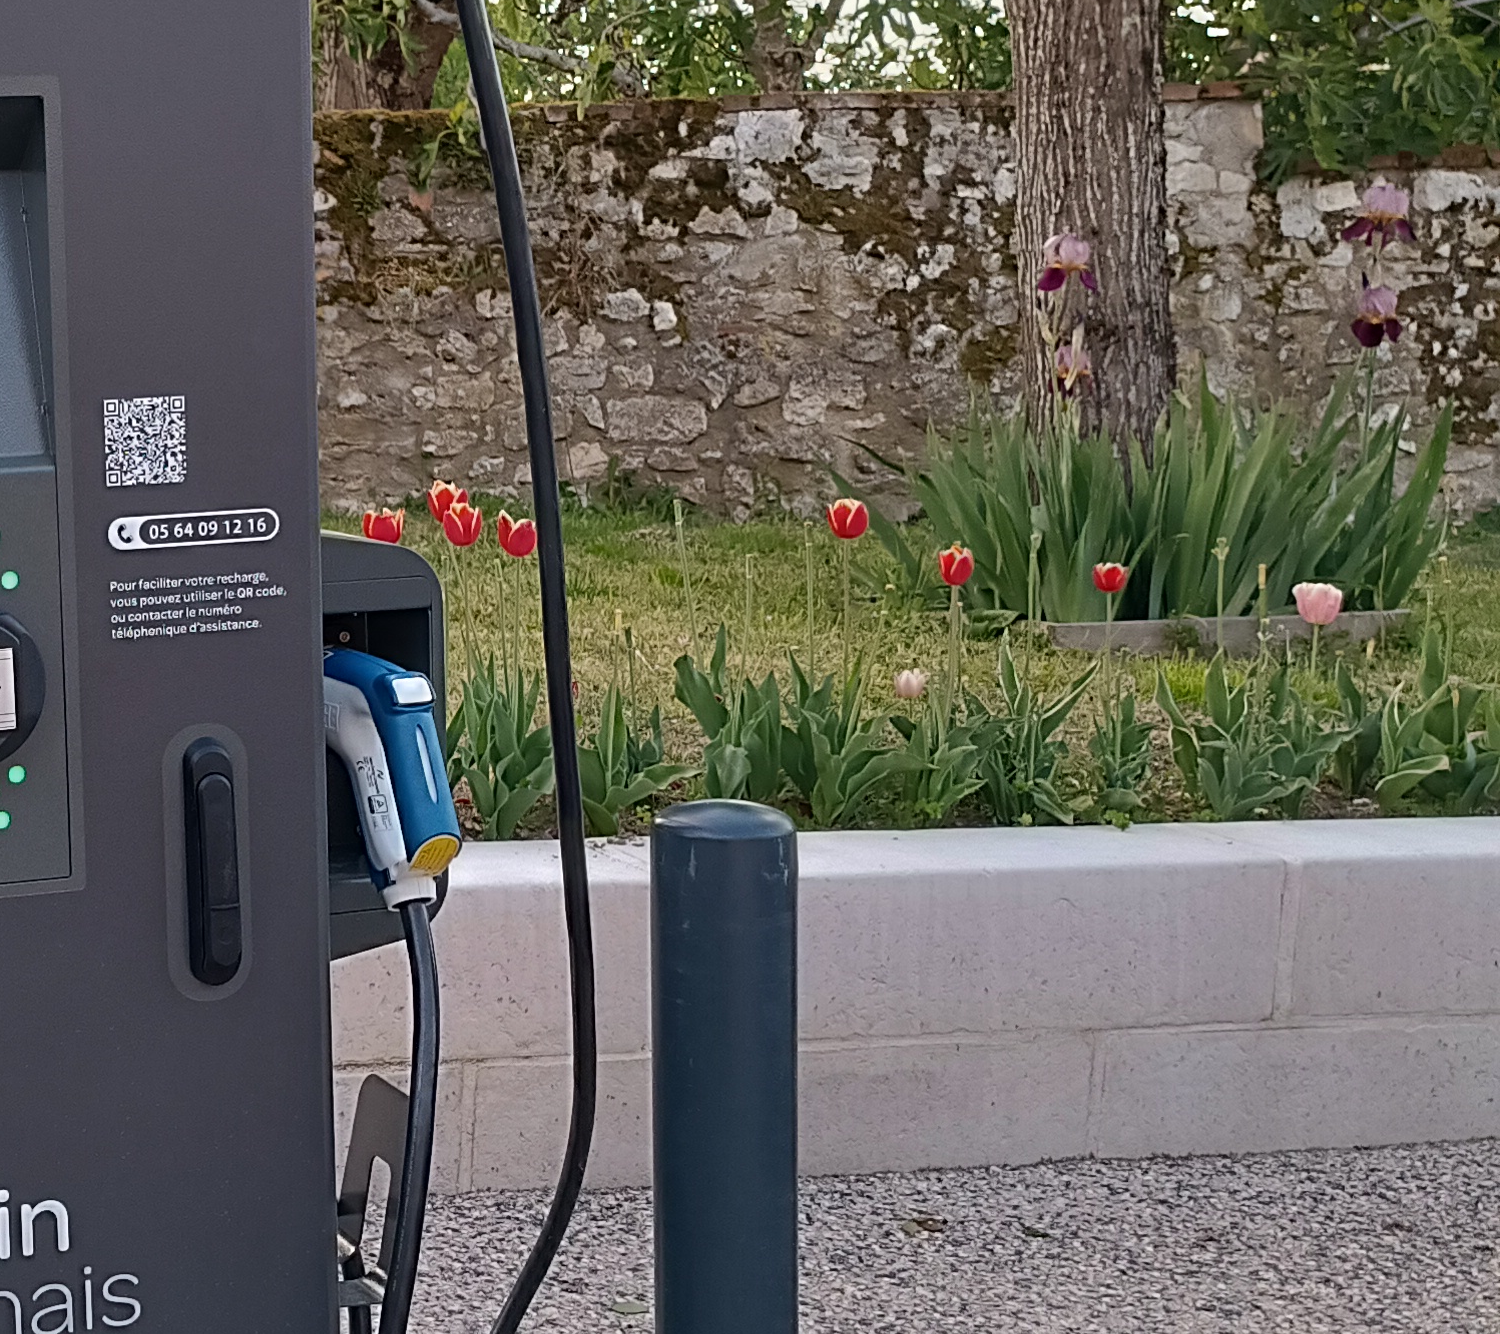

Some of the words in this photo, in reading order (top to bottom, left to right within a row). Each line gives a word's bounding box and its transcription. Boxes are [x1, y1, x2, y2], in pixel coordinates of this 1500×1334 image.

[149, 524, 169, 539] 05
[174, 522, 194, 538] 64
[198, 521, 218, 536] 09
[222, 519, 242, 534] 12
[247, 517, 267, 533] 16
[109, 581, 137, 592] Pour
[138, 576, 183, 591] faciliter
[184, 575, 216, 588] votre
[110, 597, 138, 608] vous
[139, 594, 182, 608] pouvez
[183, 589, 223, 603] utiliser
[224, 588, 235, 600] le
[236, 587, 254, 599] QR
[255, 585, 287, 598] code,
[111, 613, 126, 624] ou
[127, 608, 183, 623] contacter
[185, 606, 196, 619] le
[198, 604, 243, 617] numéro
[111, 623, 187, 640] téléphonique
